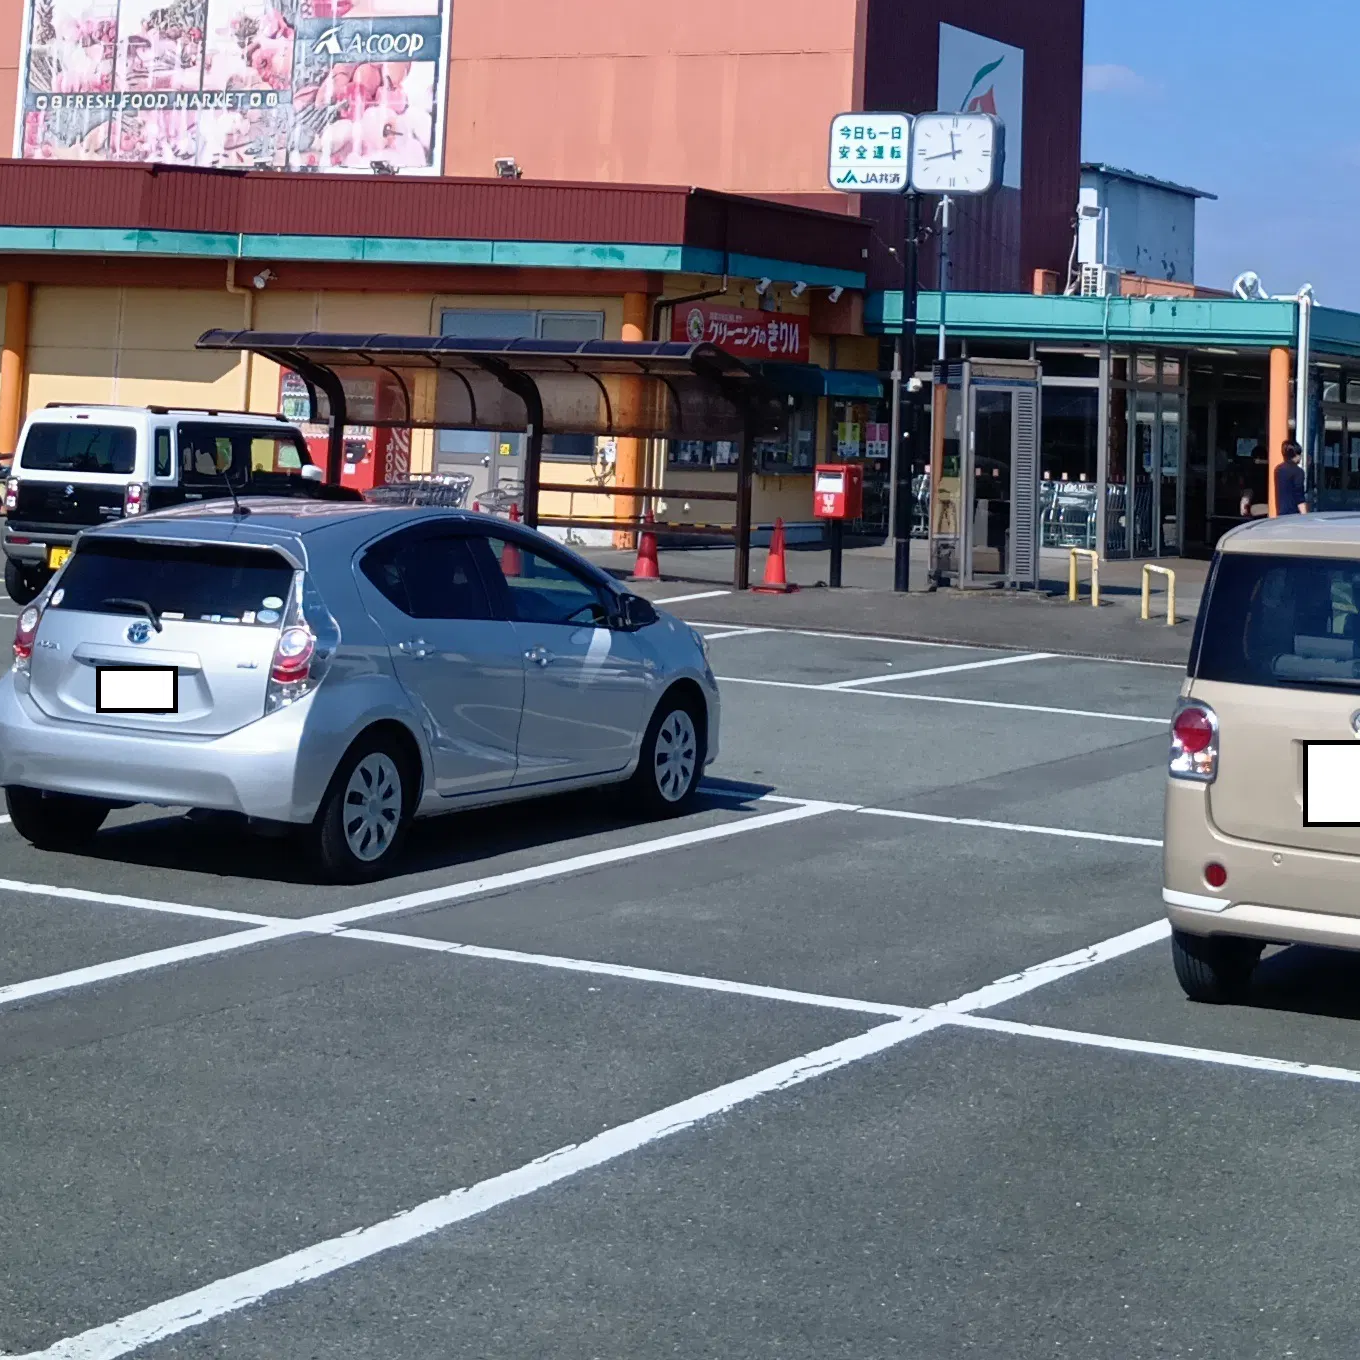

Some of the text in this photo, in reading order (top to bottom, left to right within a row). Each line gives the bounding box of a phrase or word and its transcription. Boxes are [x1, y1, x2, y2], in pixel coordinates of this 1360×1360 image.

[65, 92, 249, 110] FRESH FOOD MARKET
[839, 125, 902, 140] 今日も一日
[838, 144, 902, 159] 安全運転
